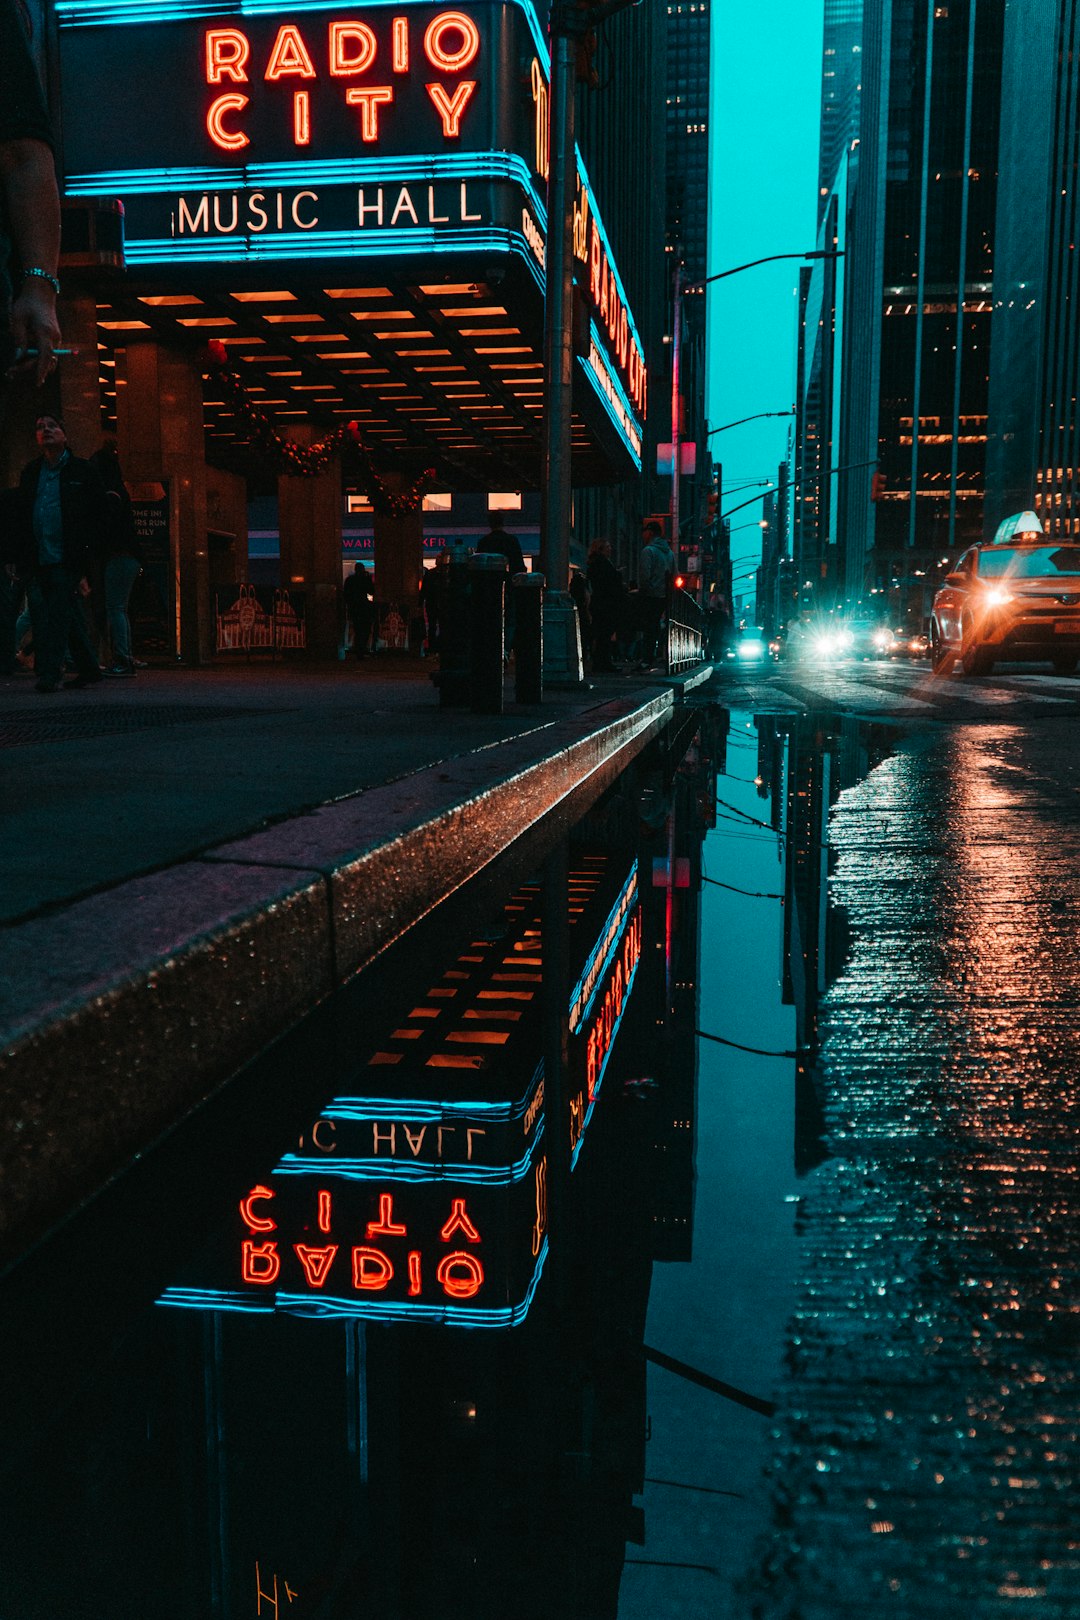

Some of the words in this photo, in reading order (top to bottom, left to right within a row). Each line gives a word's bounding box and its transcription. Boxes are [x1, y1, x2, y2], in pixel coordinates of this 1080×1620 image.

[204, 10, 481, 84] RADIO
[205, 80, 477, 151] CITY
[177, 189, 319, 234] MUSIC
[358, 180, 482, 227] HALL
[589, 216, 628, 369] RADIO
[342, 538, 375, 548] WAR
